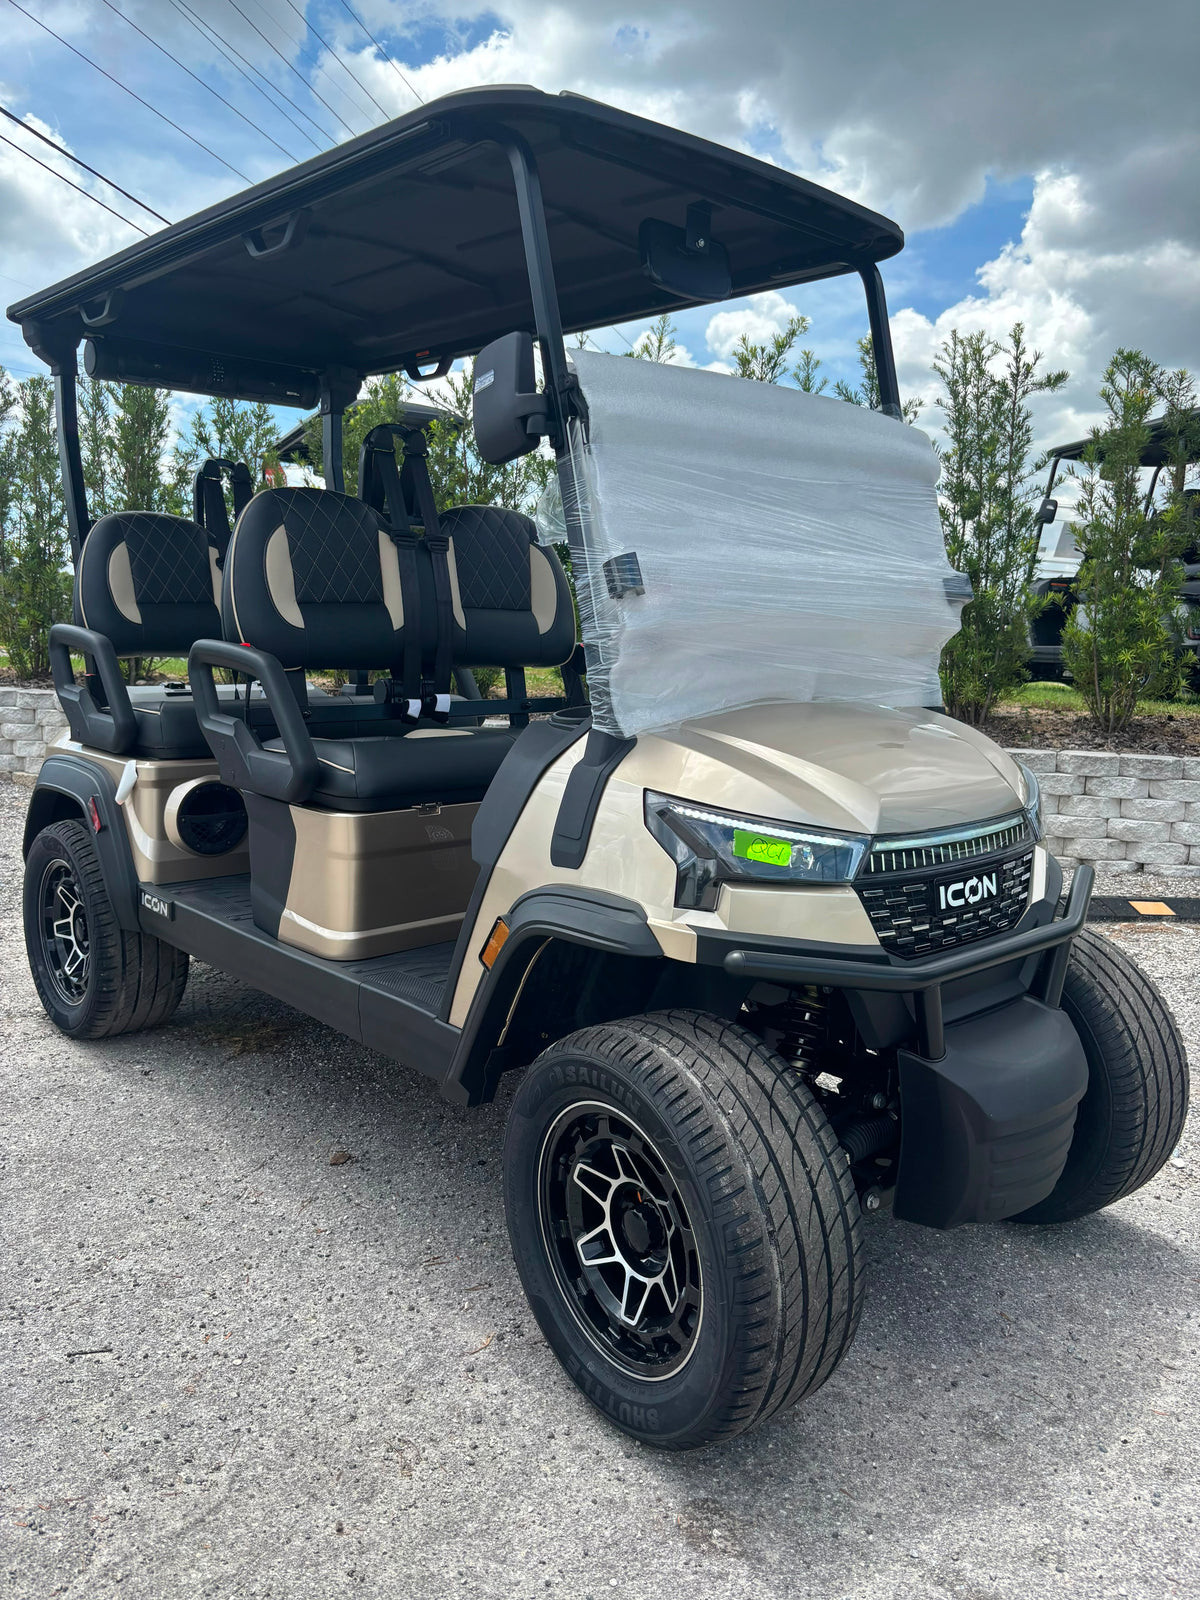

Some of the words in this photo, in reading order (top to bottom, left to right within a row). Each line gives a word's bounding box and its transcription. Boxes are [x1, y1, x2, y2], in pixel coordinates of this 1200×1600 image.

[141, 892, 168, 917] ICON
[939, 872, 997, 910] ICON
[566, 1065, 641, 1113] SAILUN
[566, 1355, 661, 1430] SHUTTLE
